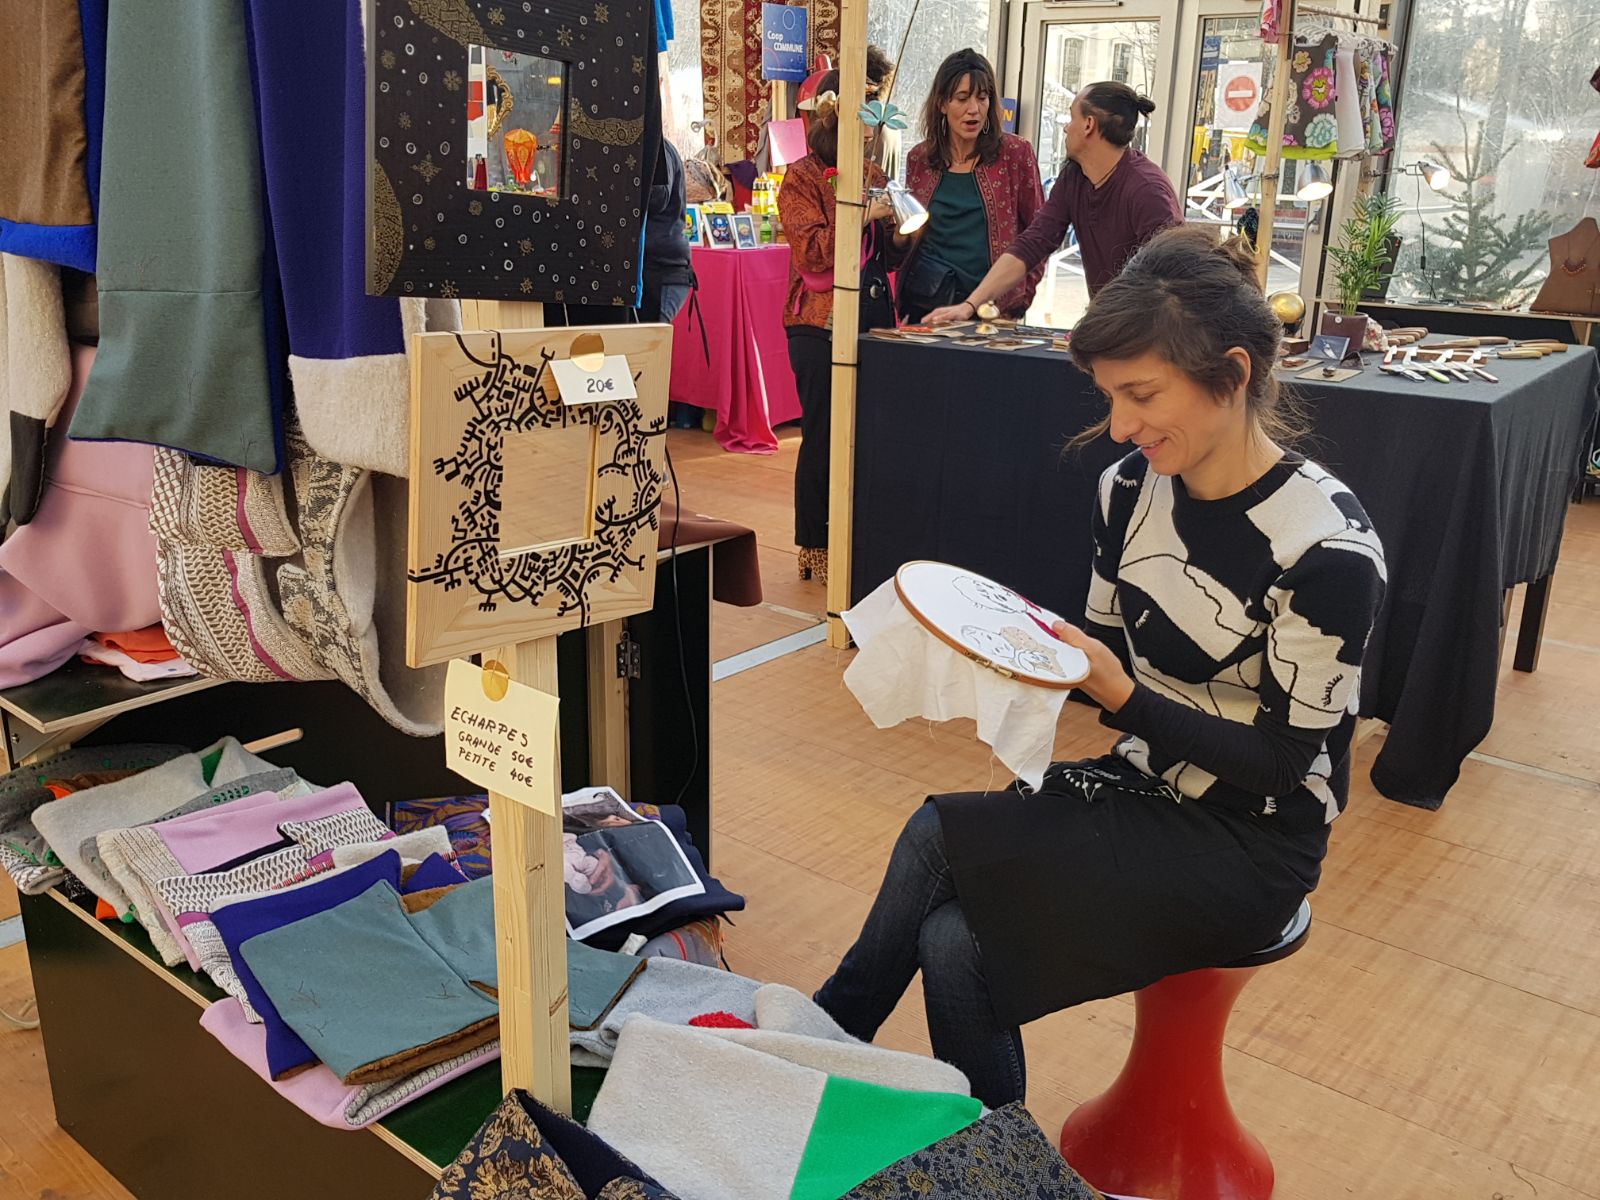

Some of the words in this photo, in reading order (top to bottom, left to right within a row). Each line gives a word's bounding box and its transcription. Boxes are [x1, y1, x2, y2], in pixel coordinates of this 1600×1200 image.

[767, 30, 784, 41] Coop
[773, 42, 803, 54] COMMUNE
[586, 378, 614, 393] 20€
[451, 707, 528, 747] ECHARPES
[458, 731, 502, 756] GRANDE
[511, 751, 534, 768] 50€
[459, 747, 497, 772] PETITE
[510, 769, 533, 788] 40€
